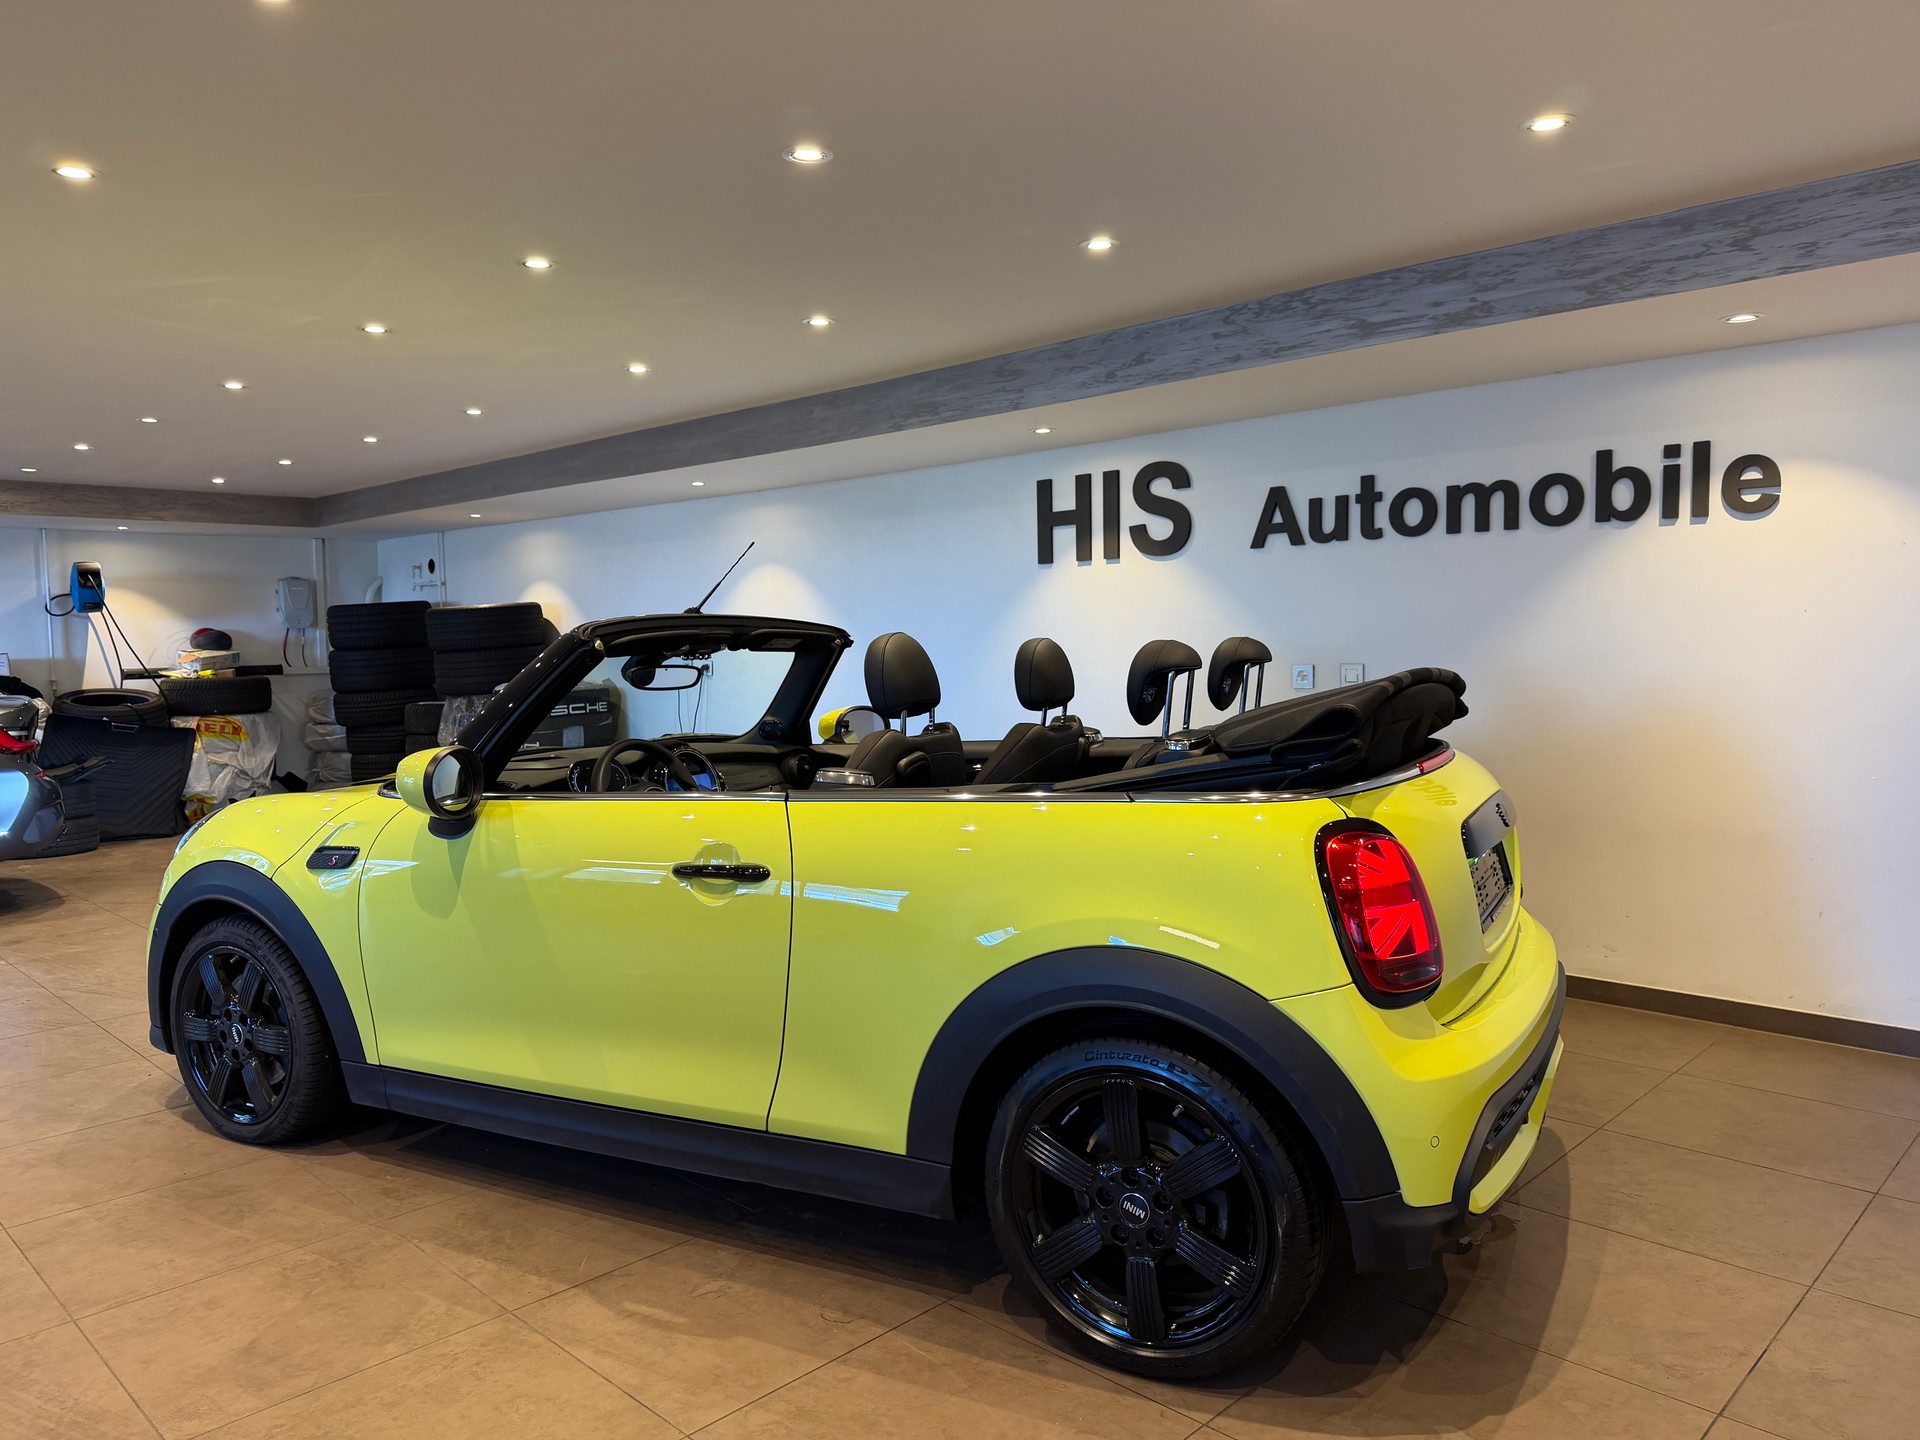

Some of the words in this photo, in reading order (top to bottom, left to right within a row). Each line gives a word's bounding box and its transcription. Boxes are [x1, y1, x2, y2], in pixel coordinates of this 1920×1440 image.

[1036, 461, 1193, 565] HIS
[1250, 440, 1783, 549] Automobile
[547, 701, 608, 717] SCHE
[328, 855, 339, 866] S
[1084, 1050, 1160, 1067] Cinturato
[1122, 1200, 1146, 1219] MINI
